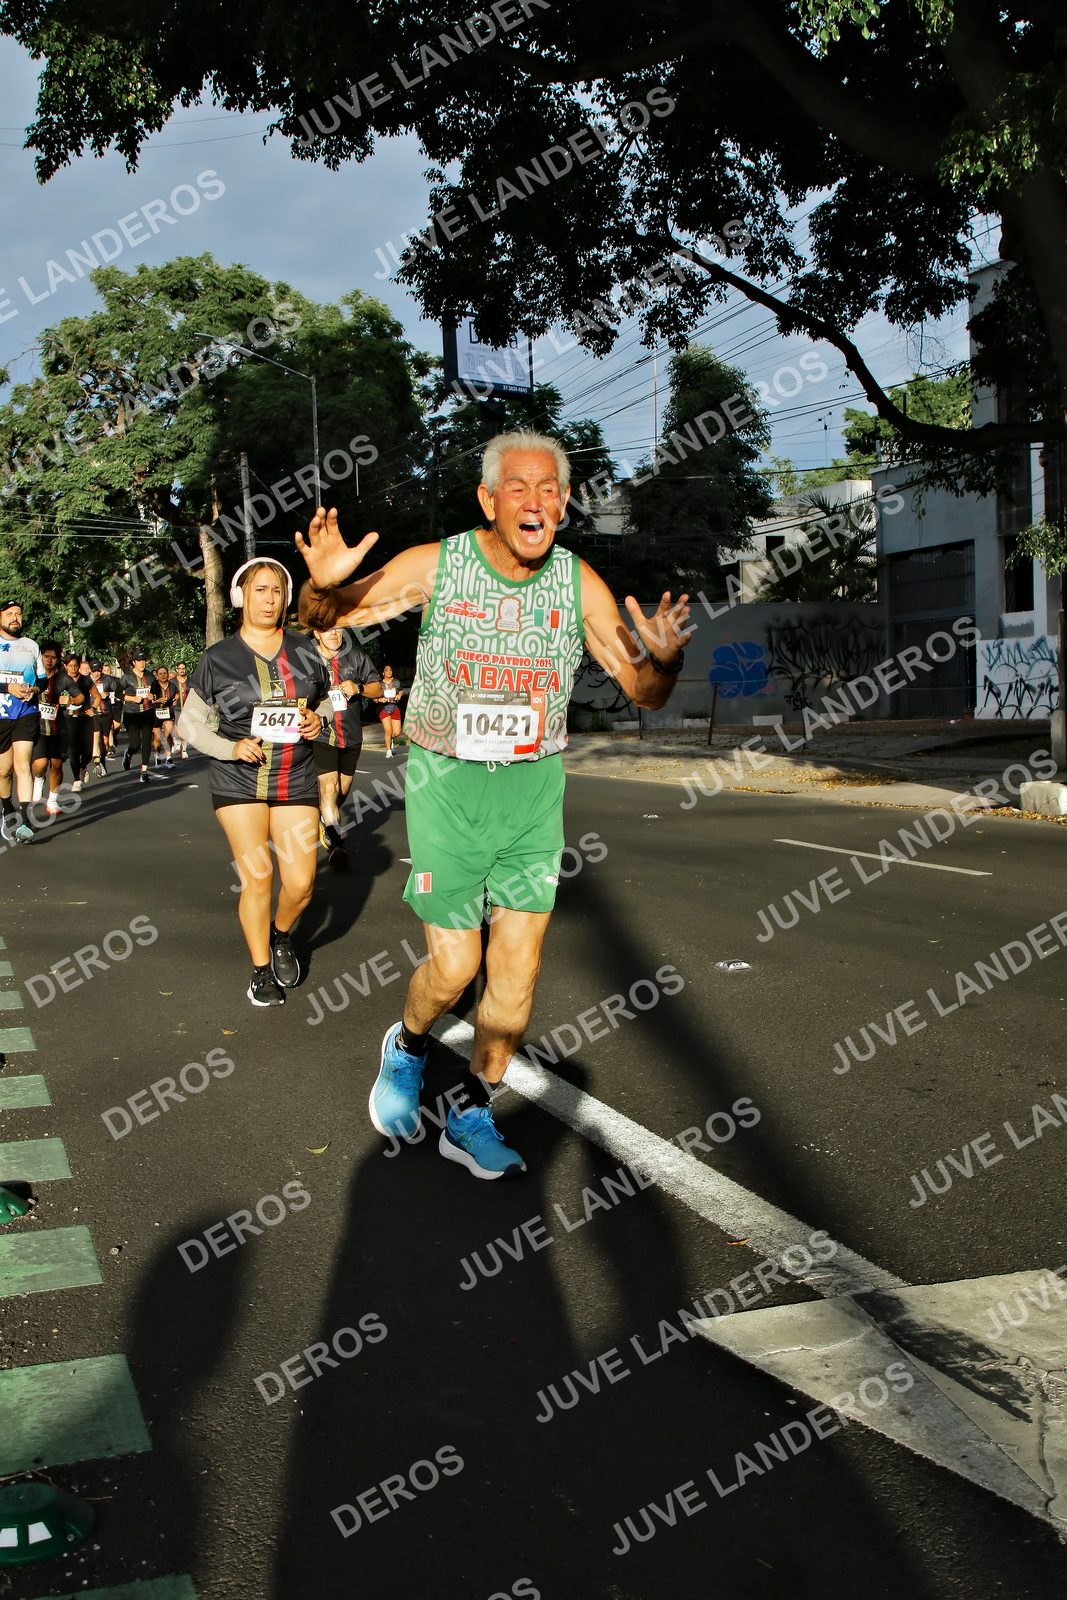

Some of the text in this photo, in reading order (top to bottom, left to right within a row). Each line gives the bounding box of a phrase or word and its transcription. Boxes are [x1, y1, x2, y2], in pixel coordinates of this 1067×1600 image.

[456, 649, 552, 668] FUEGO PATRIO 2025
[445, 658, 472, 687] LA
[479, 665, 560, 693] BARCA
[258, 712, 296, 727] 2647
[462, 713, 532, 737] 10421
